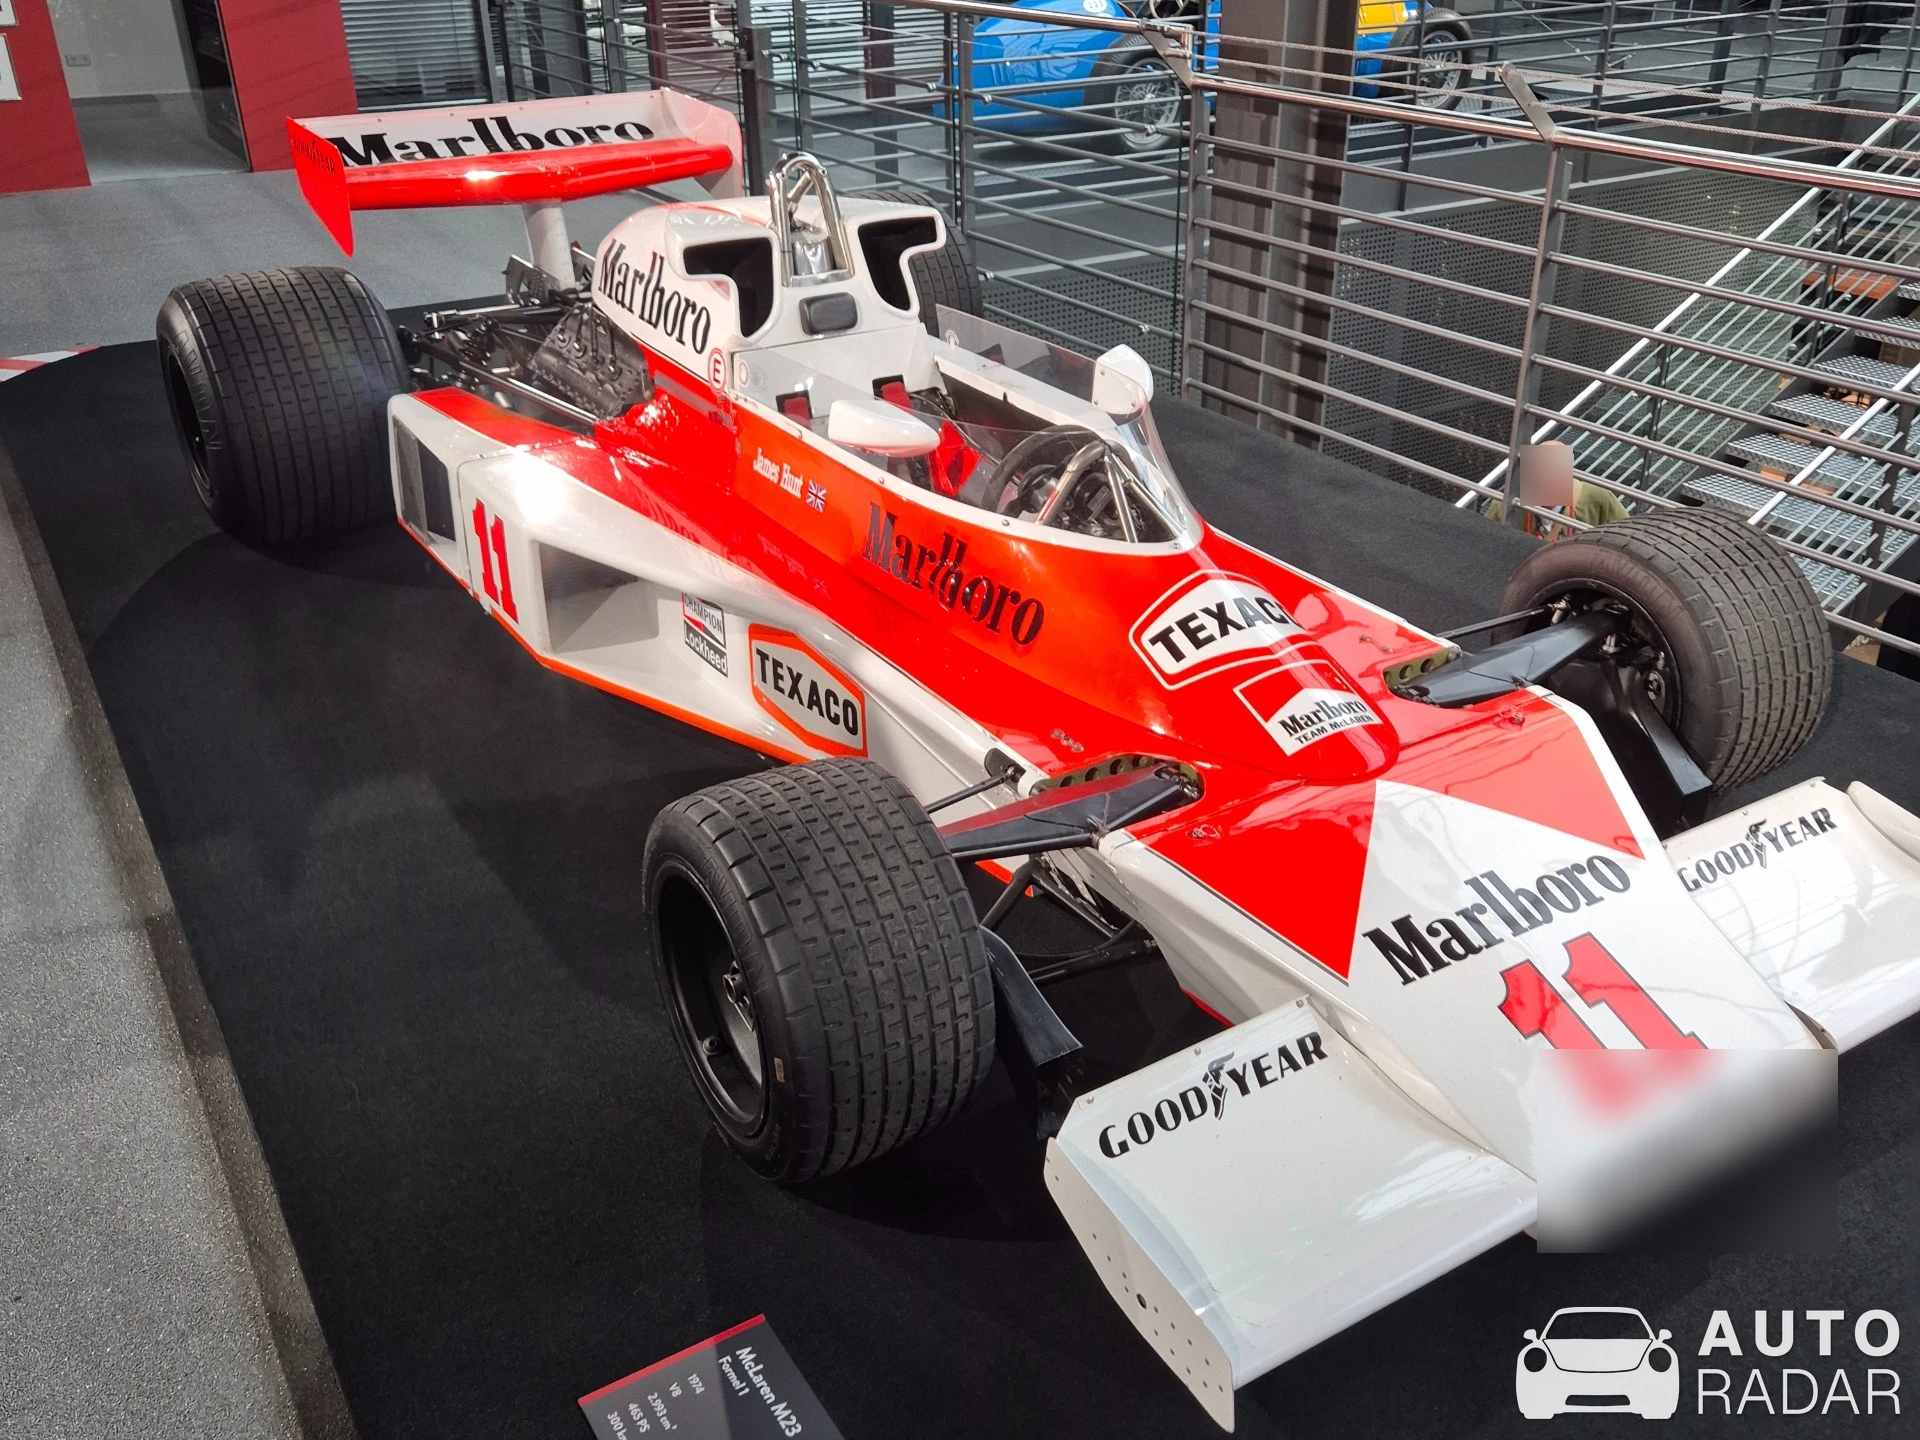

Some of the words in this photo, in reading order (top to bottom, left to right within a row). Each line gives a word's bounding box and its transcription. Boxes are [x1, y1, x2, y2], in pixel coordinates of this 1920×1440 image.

[324, 116, 655, 167] Marlboro
[598, 238, 711, 354] Marlboro
[753, 447, 780, 484] James
[780, 462, 804, 499] Hunt
[472, 497, 519, 625] 11
[863, 501, 1045, 646] Marlboro
[684, 593, 723, 634] CHAMPION
[1148, 597, 1305, 664] TEXAC
[685, 622, 727, 674] Lockheed
[755, 647, 859, 736] TEXACO
[1277, 700, 1367, 737] Marlboro
[1294, 726, 1328, 744] TEAM
[1329, 715, 1374, 731] McLAREN
[1677, 807, 1838, 892] GOODYEAR
[1361, 855, 1632, 987] Marlboro
[1498, 931, 1710, 1050] 11
[1099, 1031, 1329, 1158] GOODYEAR
[669, 1381, 682, 1398] V8
[687, 1373, 705, 1395] 1974
[718, 1355, 747, 1391] Formel
[738, 1387, 750, 1397] 1
[735, 1346, 776, 1405] McLaren
[770, 1401, 802, 1437] M23
[607, 1411, 624, 1431] 300
[628, 1403, 643, 1421] 465
[636, 1418, 650, 1433] PS
